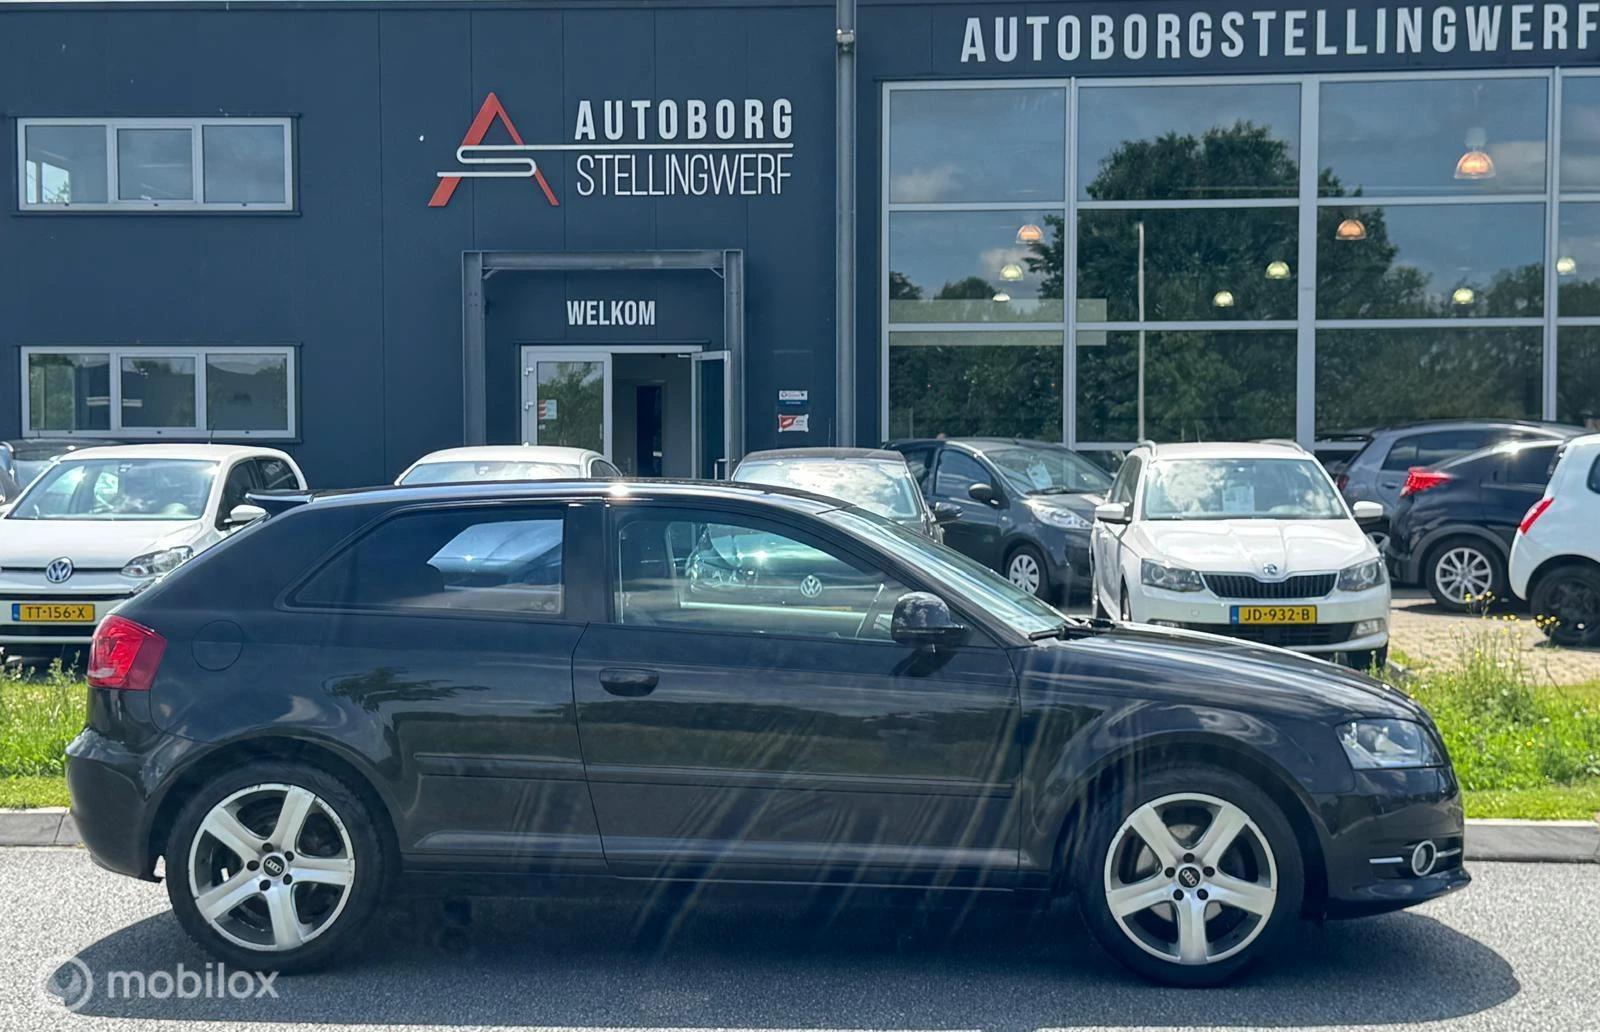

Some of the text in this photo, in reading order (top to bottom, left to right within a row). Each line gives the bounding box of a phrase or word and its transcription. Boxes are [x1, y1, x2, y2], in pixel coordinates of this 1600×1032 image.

[961, 3, 1599, 62] AUTOBORGSTELLINGWERF
[575, 98, 792, 140] AUTOBORG
[576, 153, 793, 196] STELLINGWERF
[566, 300, 655, 325] WELKOM
[26, 606, 85, 619] TT-156-X
[1245, 608, 1310, 621] JD-932-B
